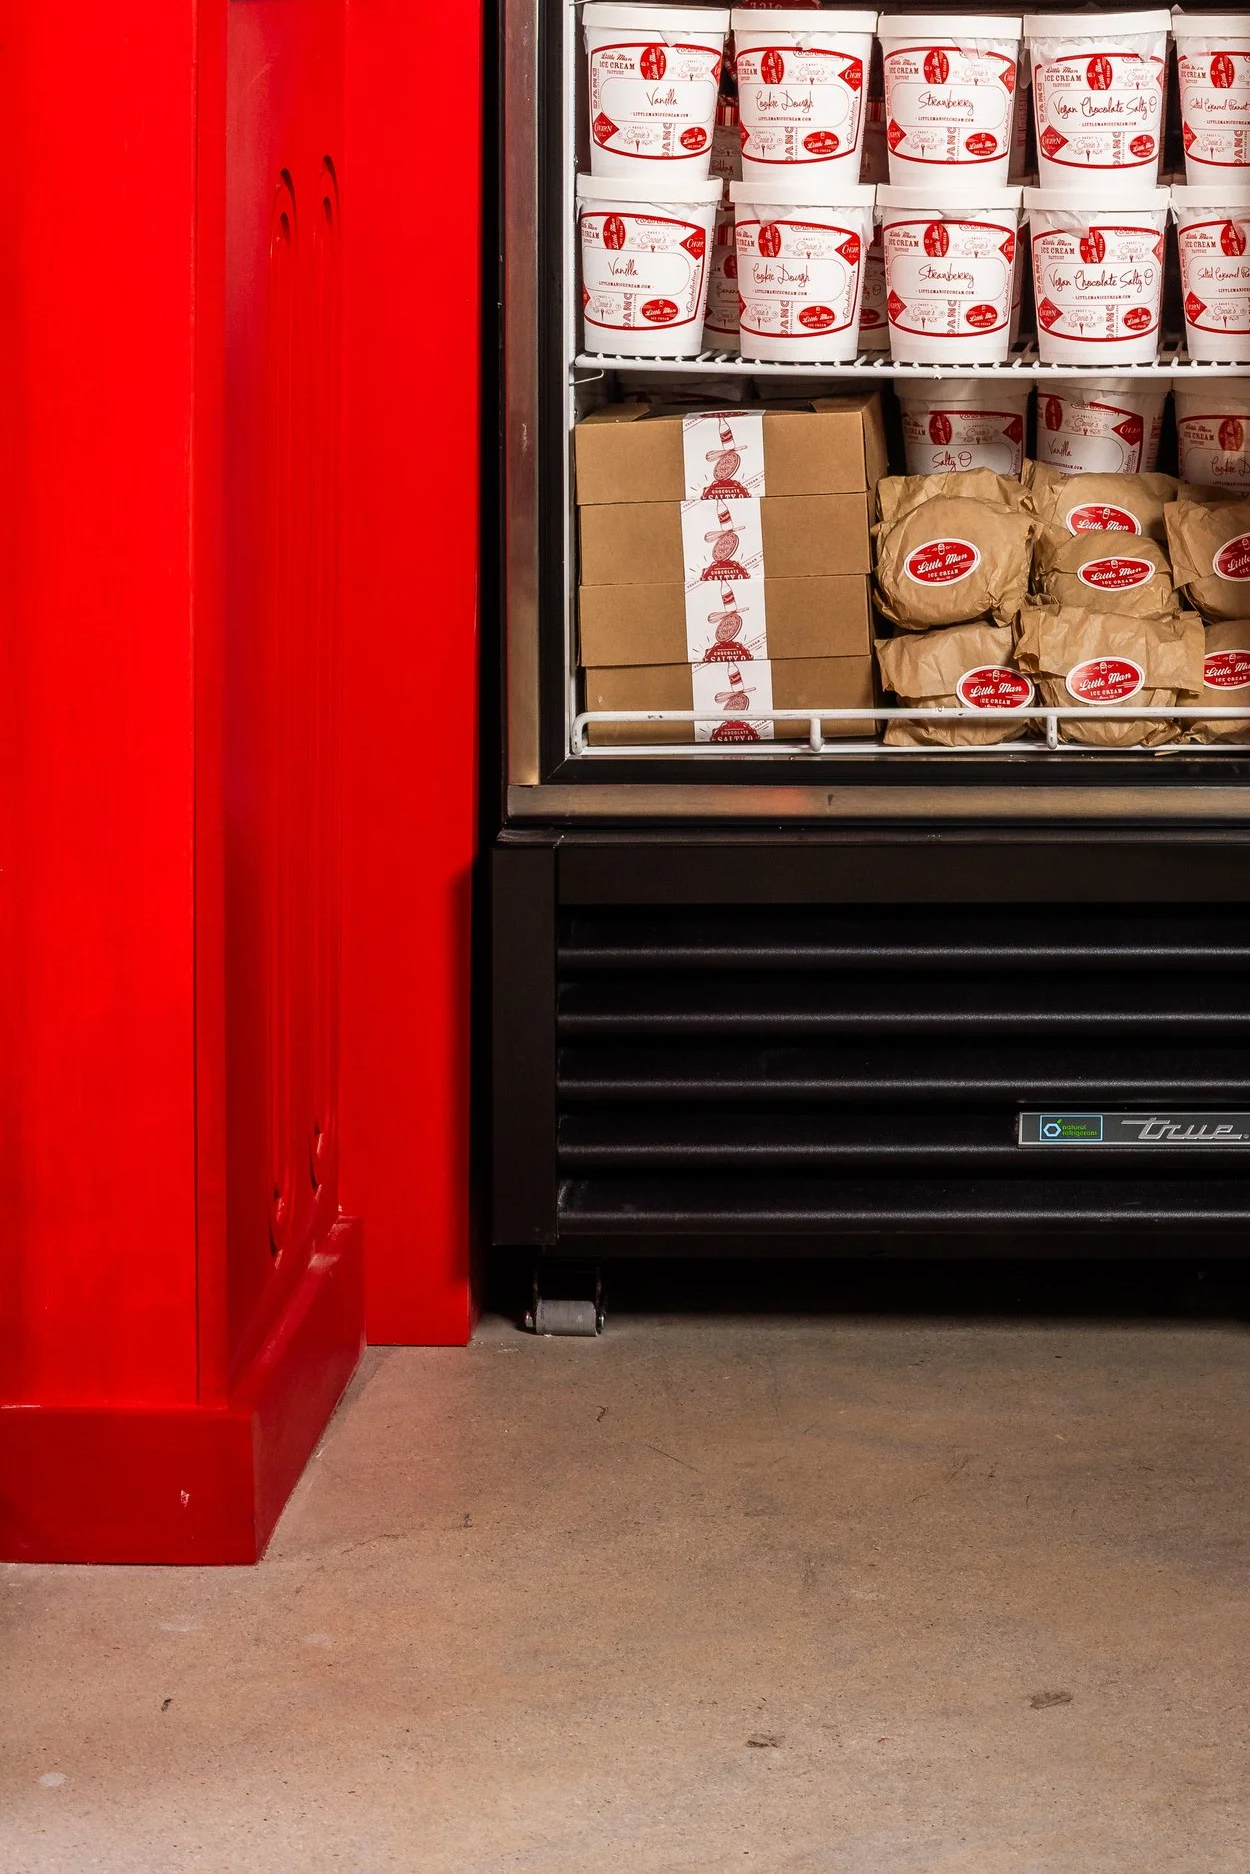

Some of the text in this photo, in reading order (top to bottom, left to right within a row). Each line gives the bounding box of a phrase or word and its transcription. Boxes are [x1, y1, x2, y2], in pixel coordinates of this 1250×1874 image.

[646, 87, 678, 107] Vanilla
[755, 90, 814, 114] Cookie Dough
[917, 89, 974, 116] Strawberry
[1053, 97, 1078, 119] Vegan
[1080, 97, 1124, 118] Chocolate
[1126, 96, 1148, 120] Salty
[607, 256, 639, 277] Vanilla
[752, 263, 811, 288] Cookie Dough
[918, 263, 975, 289] Strawberry
[1048, 269, 1153, 293] Vegan Chocolate Salty O
[1047, 437, 1072, 457] Vanilla
[932, 451, 972, 473] Salty O
[1076, 519, 1130, 531] Little Man
[917, 552, 969, 575] Little Man
[1090, 567, 1143, 581] Little Man
[1079, 672, 1132, 692] Little Man
[1205, 666, 1232, 677] Little
[969, 682, 1023, 698] Little Man
